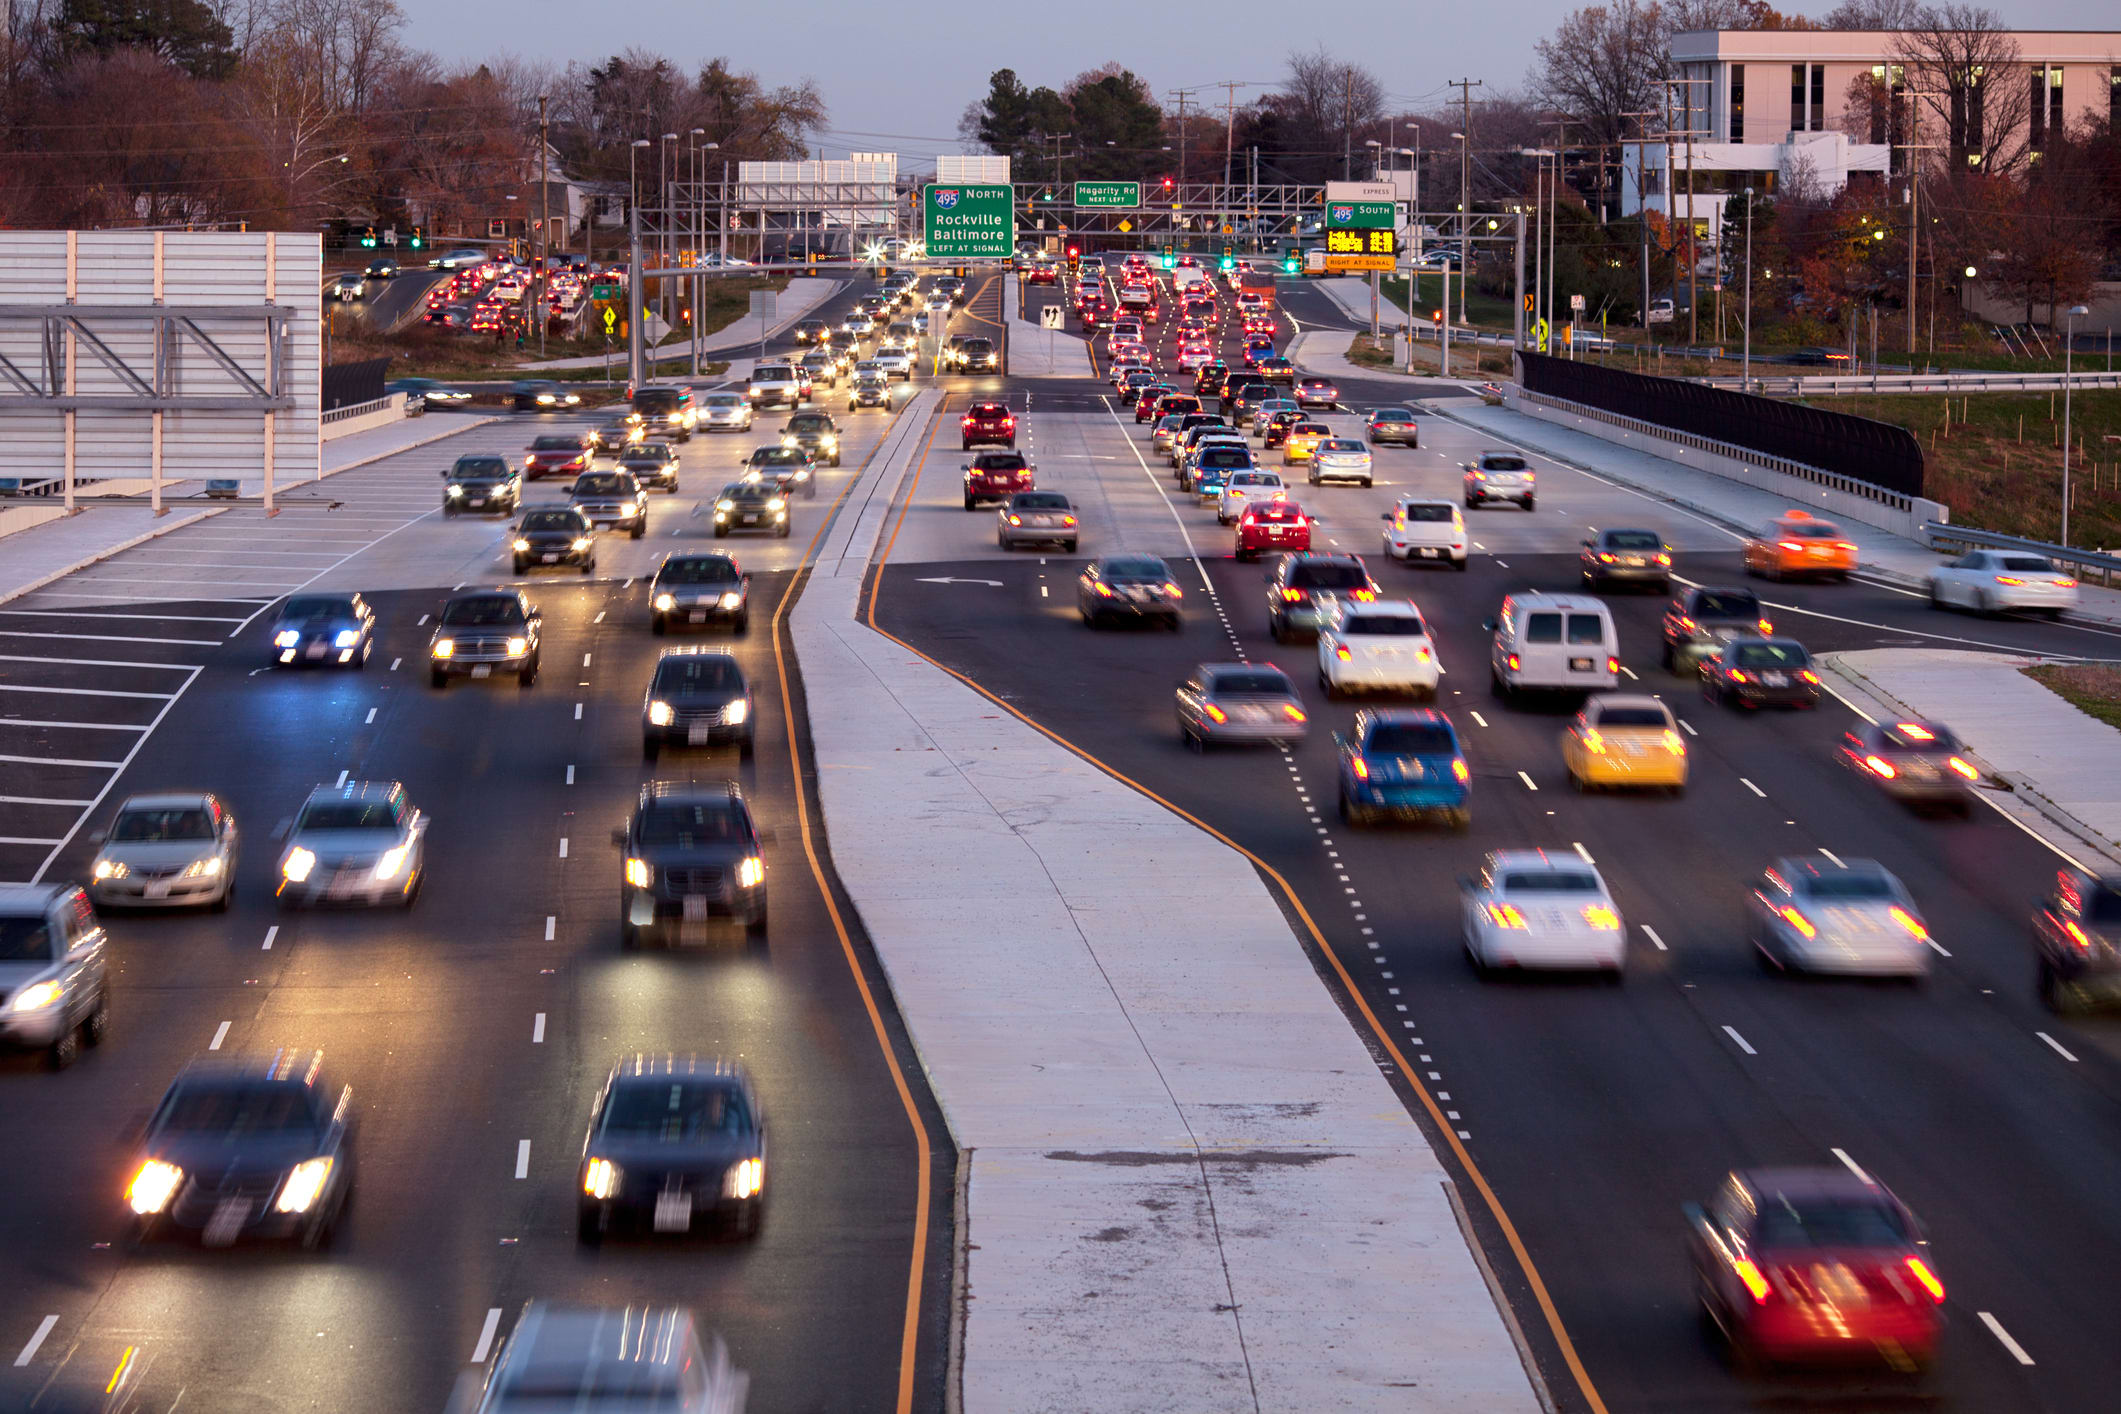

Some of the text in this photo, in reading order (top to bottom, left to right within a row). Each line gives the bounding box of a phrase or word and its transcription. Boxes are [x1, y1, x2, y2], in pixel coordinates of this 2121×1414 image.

[1079, 187, 1119, 196] Magarity
[937, 189, 1004, 206] 495 NORTH
[1335, 205, 1390, 220] 495 SOUTH
[936, 214, 1002, 225] Rockville
[934, 229, 1005, 240] Baltimore
[933, 244, 1005, 252] LEFT AT SIGNAL
